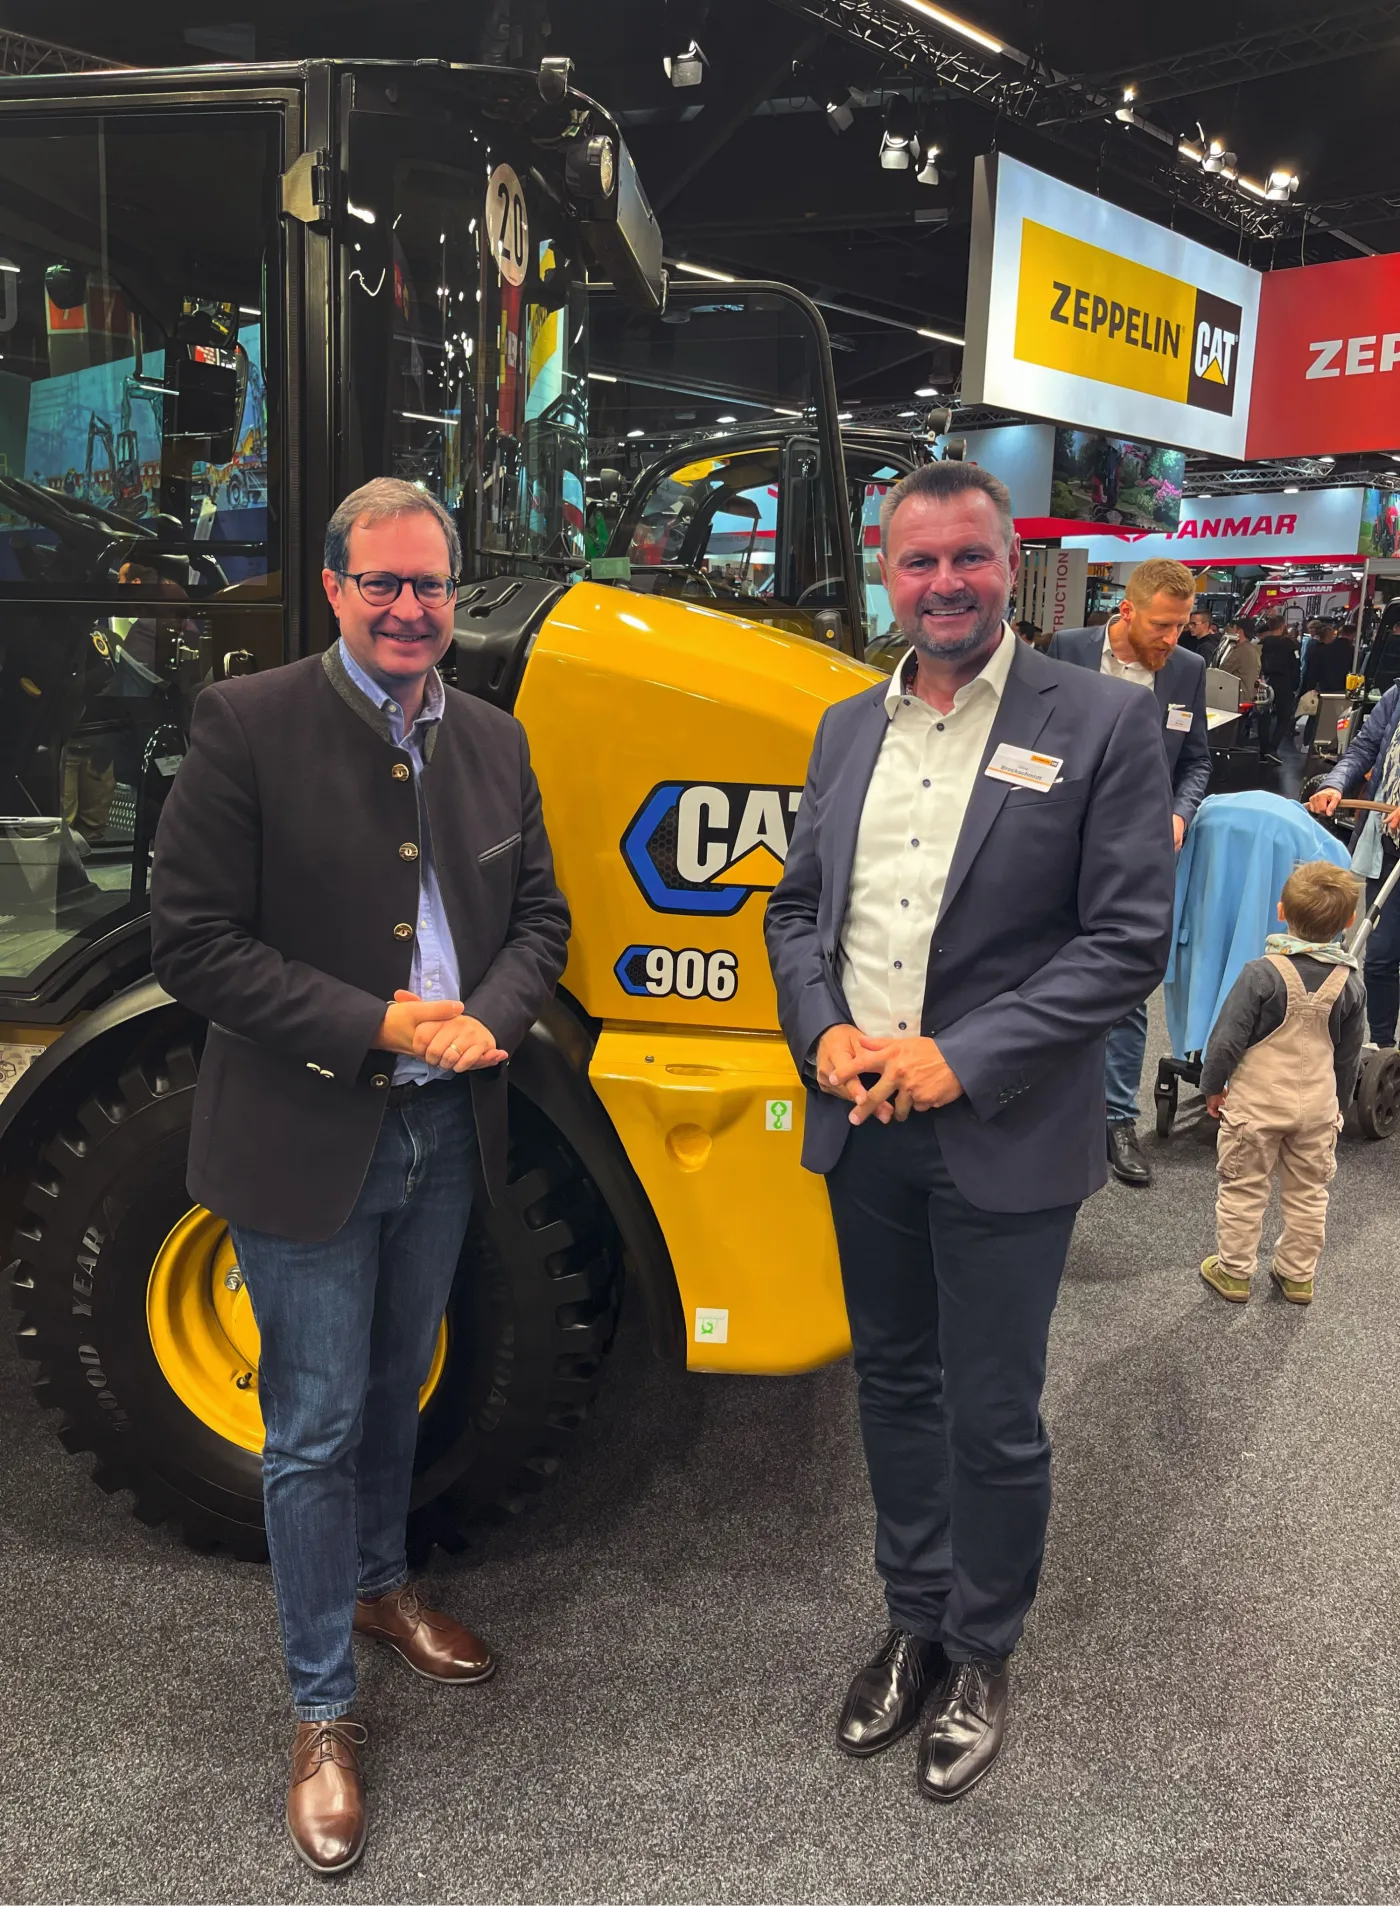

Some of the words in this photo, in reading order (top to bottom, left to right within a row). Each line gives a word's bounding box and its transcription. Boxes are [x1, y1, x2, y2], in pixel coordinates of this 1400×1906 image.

[498, 183, 523, 267] 20
[1050, 280, 1181, 359] ZEPPELIN
[1194, 321, 1236, 386] CAT
[1306, 333, 1400, 380] ZEP
[1001, 765, 1042, 781] Brockschmidt
[676, 785, 802, 883] CA
[645, 948, 736, 999] 906
[72, 1225, 106, 1317] YEAR
